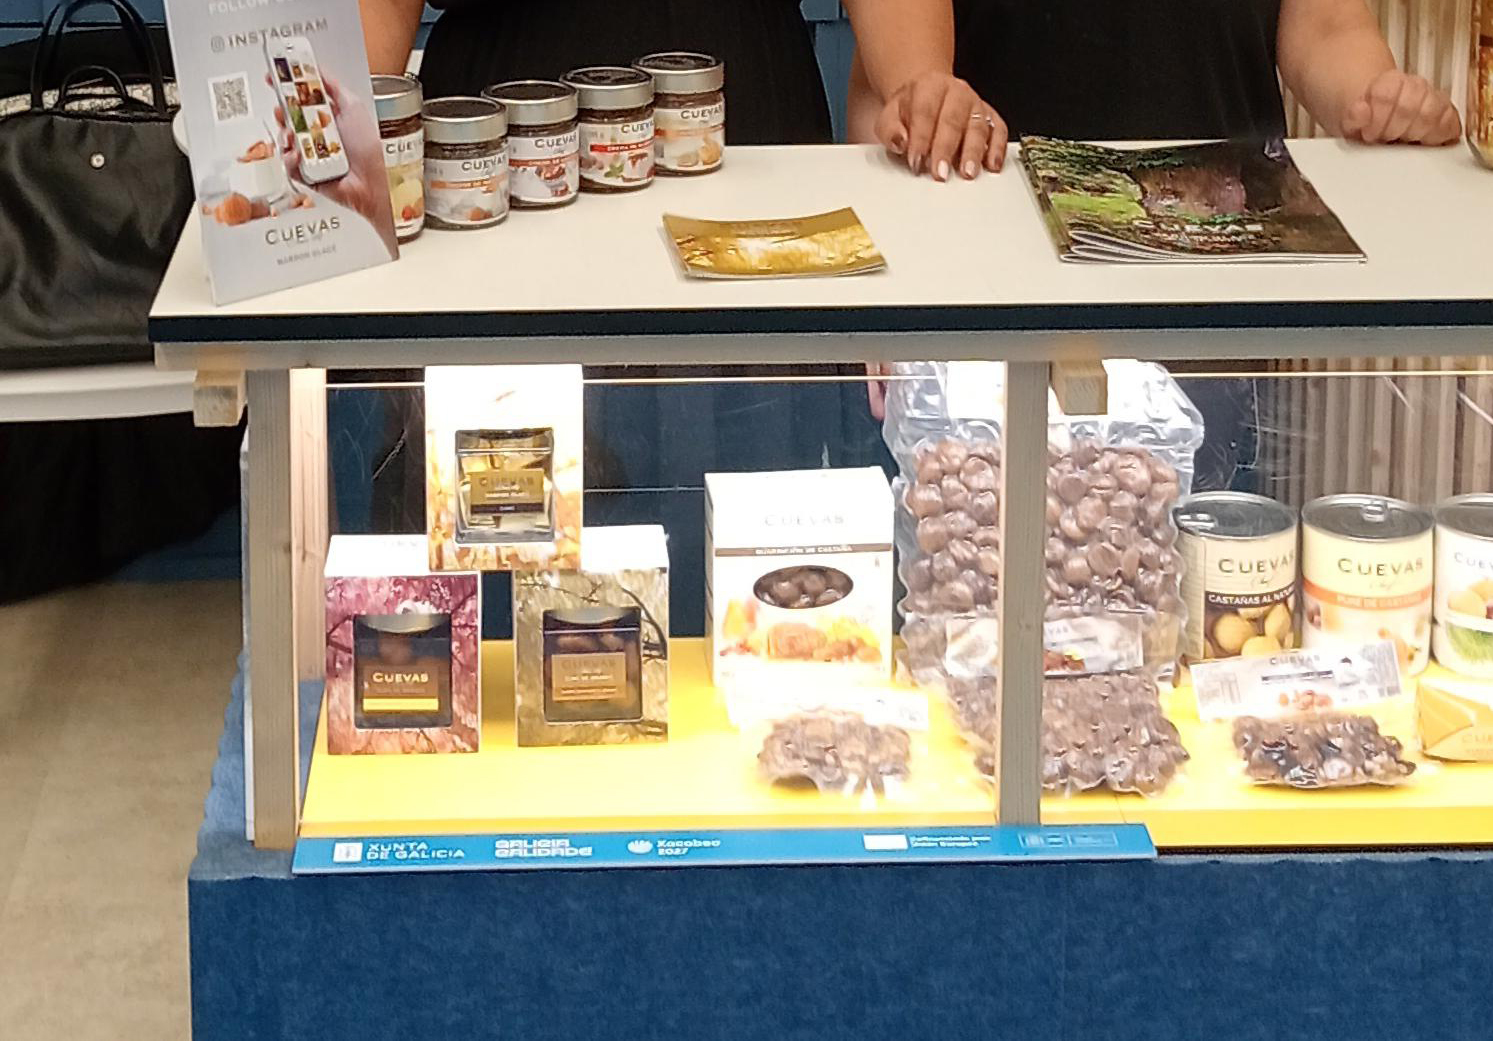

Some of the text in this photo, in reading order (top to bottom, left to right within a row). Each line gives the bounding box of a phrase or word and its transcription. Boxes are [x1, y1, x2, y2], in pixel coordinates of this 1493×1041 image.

[228, 17, 328, 48] INSTAGRAM
[265, 216, 341, 246] CUEVAS
[1338, 557, 1423, 577] CUEVAS
[1207, 593, 1260, 605] CASTAÑAS
[372, 671, 430, 684] CUEVAS
[369, 841, 429, 851] XUNTA
[395, 848, 465, 860] GALICIA
